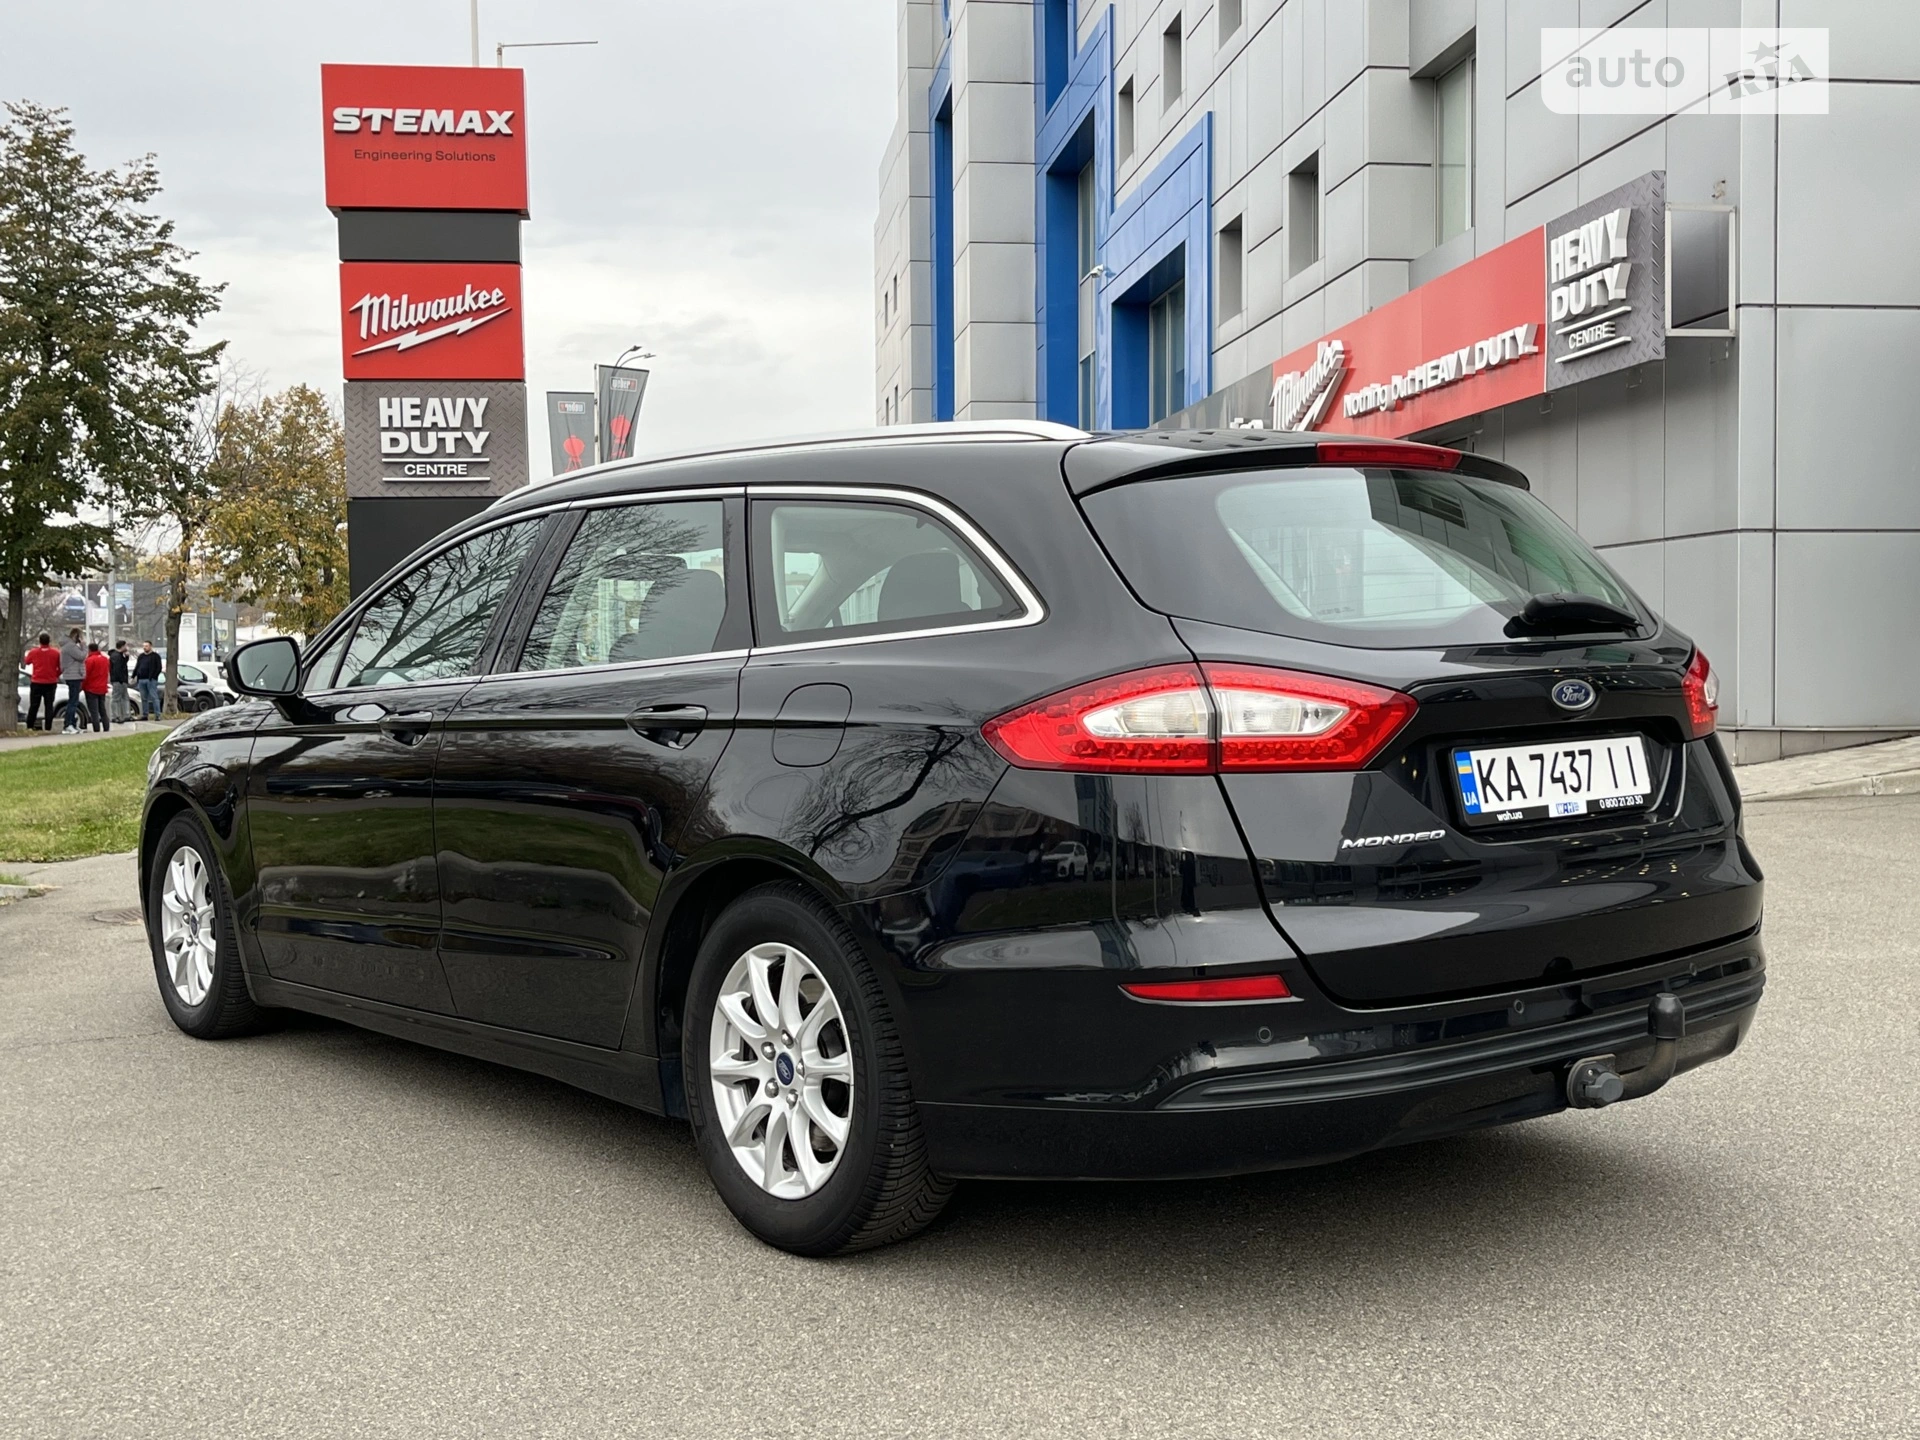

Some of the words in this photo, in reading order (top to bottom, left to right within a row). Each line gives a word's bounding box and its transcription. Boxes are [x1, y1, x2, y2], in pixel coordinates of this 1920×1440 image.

[333, 106, 515, 136] STEMAX
[354, 149, 432, 163] Engineering
[436, 150, 496, 162] Solutions
[1550, 208, 1631, 284] HEAVY
[1551, 263, 1631, 322] DUTY
[349, 284, 507, 340] Milwaukee
[1568, 321, 1616, 350] CENTRE
[1343, 382, 1396, 418] Nothing
[1391, 374, 1420, 402] but
[1415, 346, 1477, 393] HEAVY
[378, 397, 489, 429] HEAVY
[380, 431, 490, 455] DUTY
[404, 462, 467, 476] CENTRE
[1561, 684, 1586, 702] Ford
[1476, 755, 1528, 802] KA
[1529, 748, 1593, 798] 7437
[1463, 792, 1479, 806] UA
[1605, 797, 1619, 808] 800
[1497, 811, 1523, 822] wah.ua
[1341, 829, 1446, 849] MONDEO
